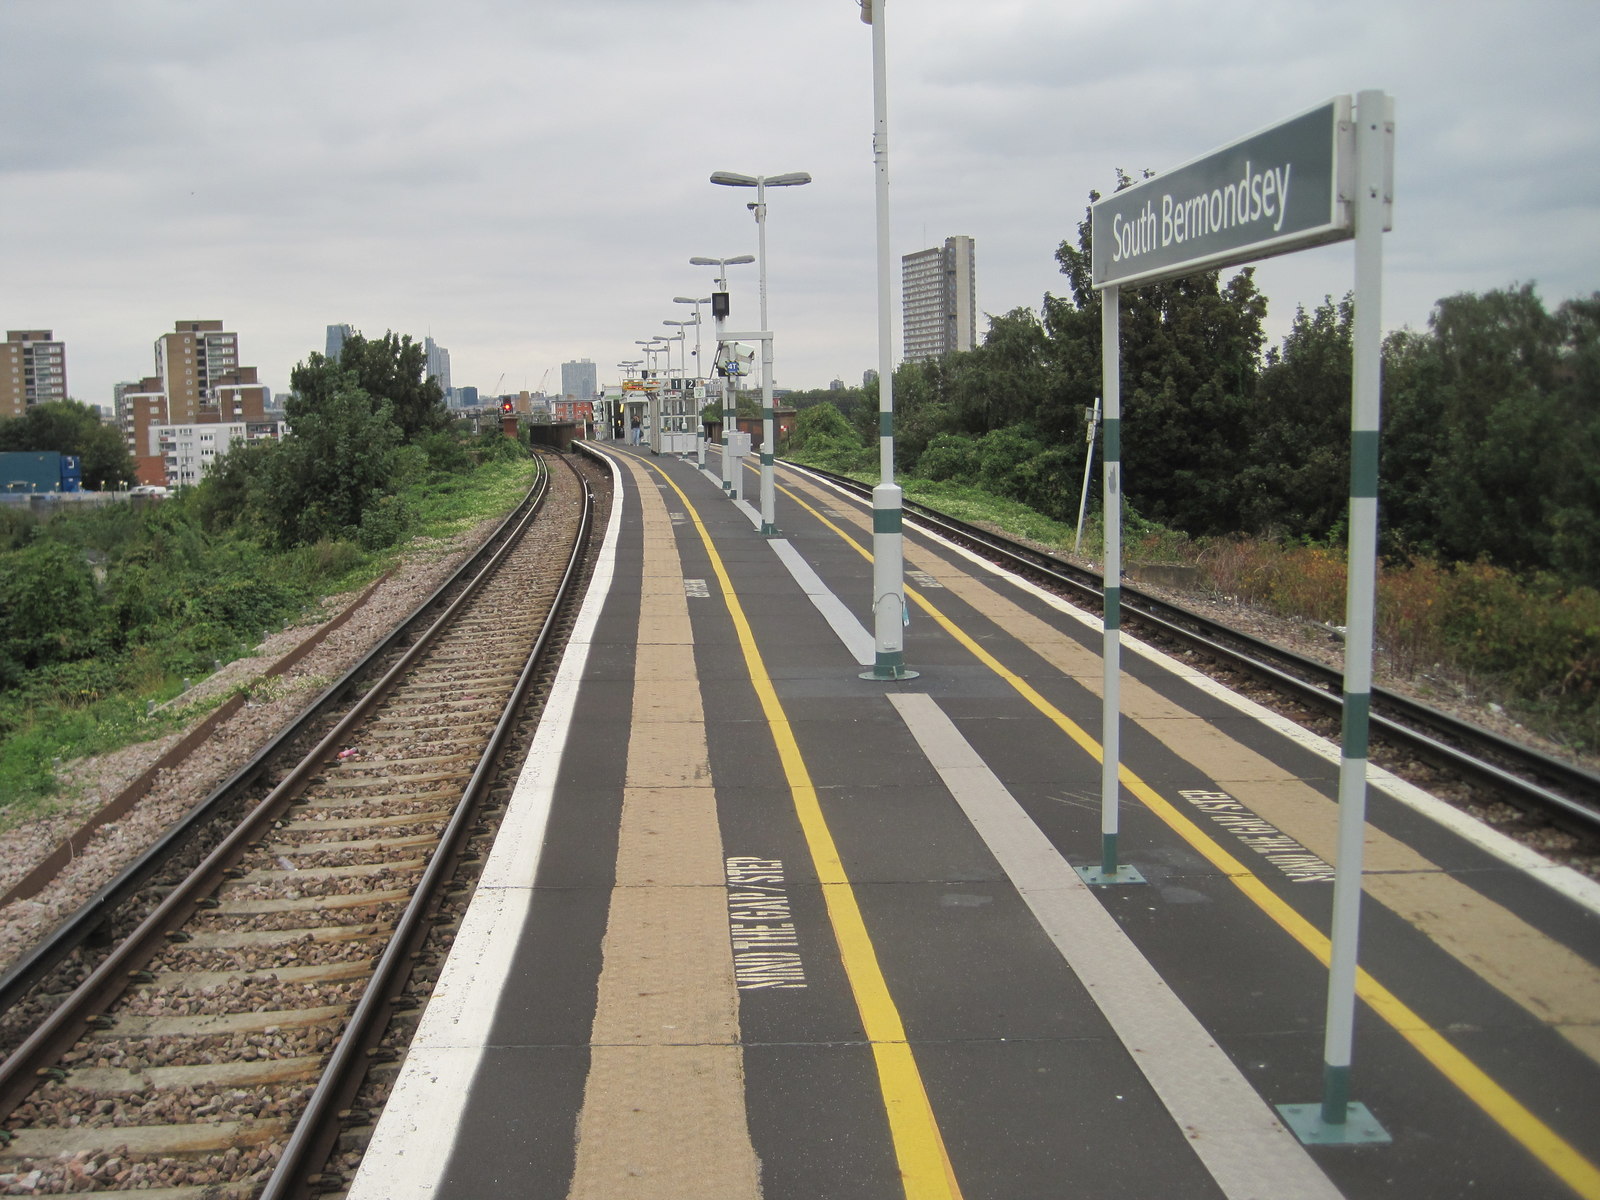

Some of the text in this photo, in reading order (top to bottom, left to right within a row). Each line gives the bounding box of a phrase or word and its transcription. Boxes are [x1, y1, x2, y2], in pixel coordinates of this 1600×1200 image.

[1112, 161, 1291, 262] South Bermondsey
[1236, 835, 1307, 854] THE
[1265, 854, 1336, 883] MIND
[731, 923, 799, 949] THE
[735, 952, 808, 990] MIND
